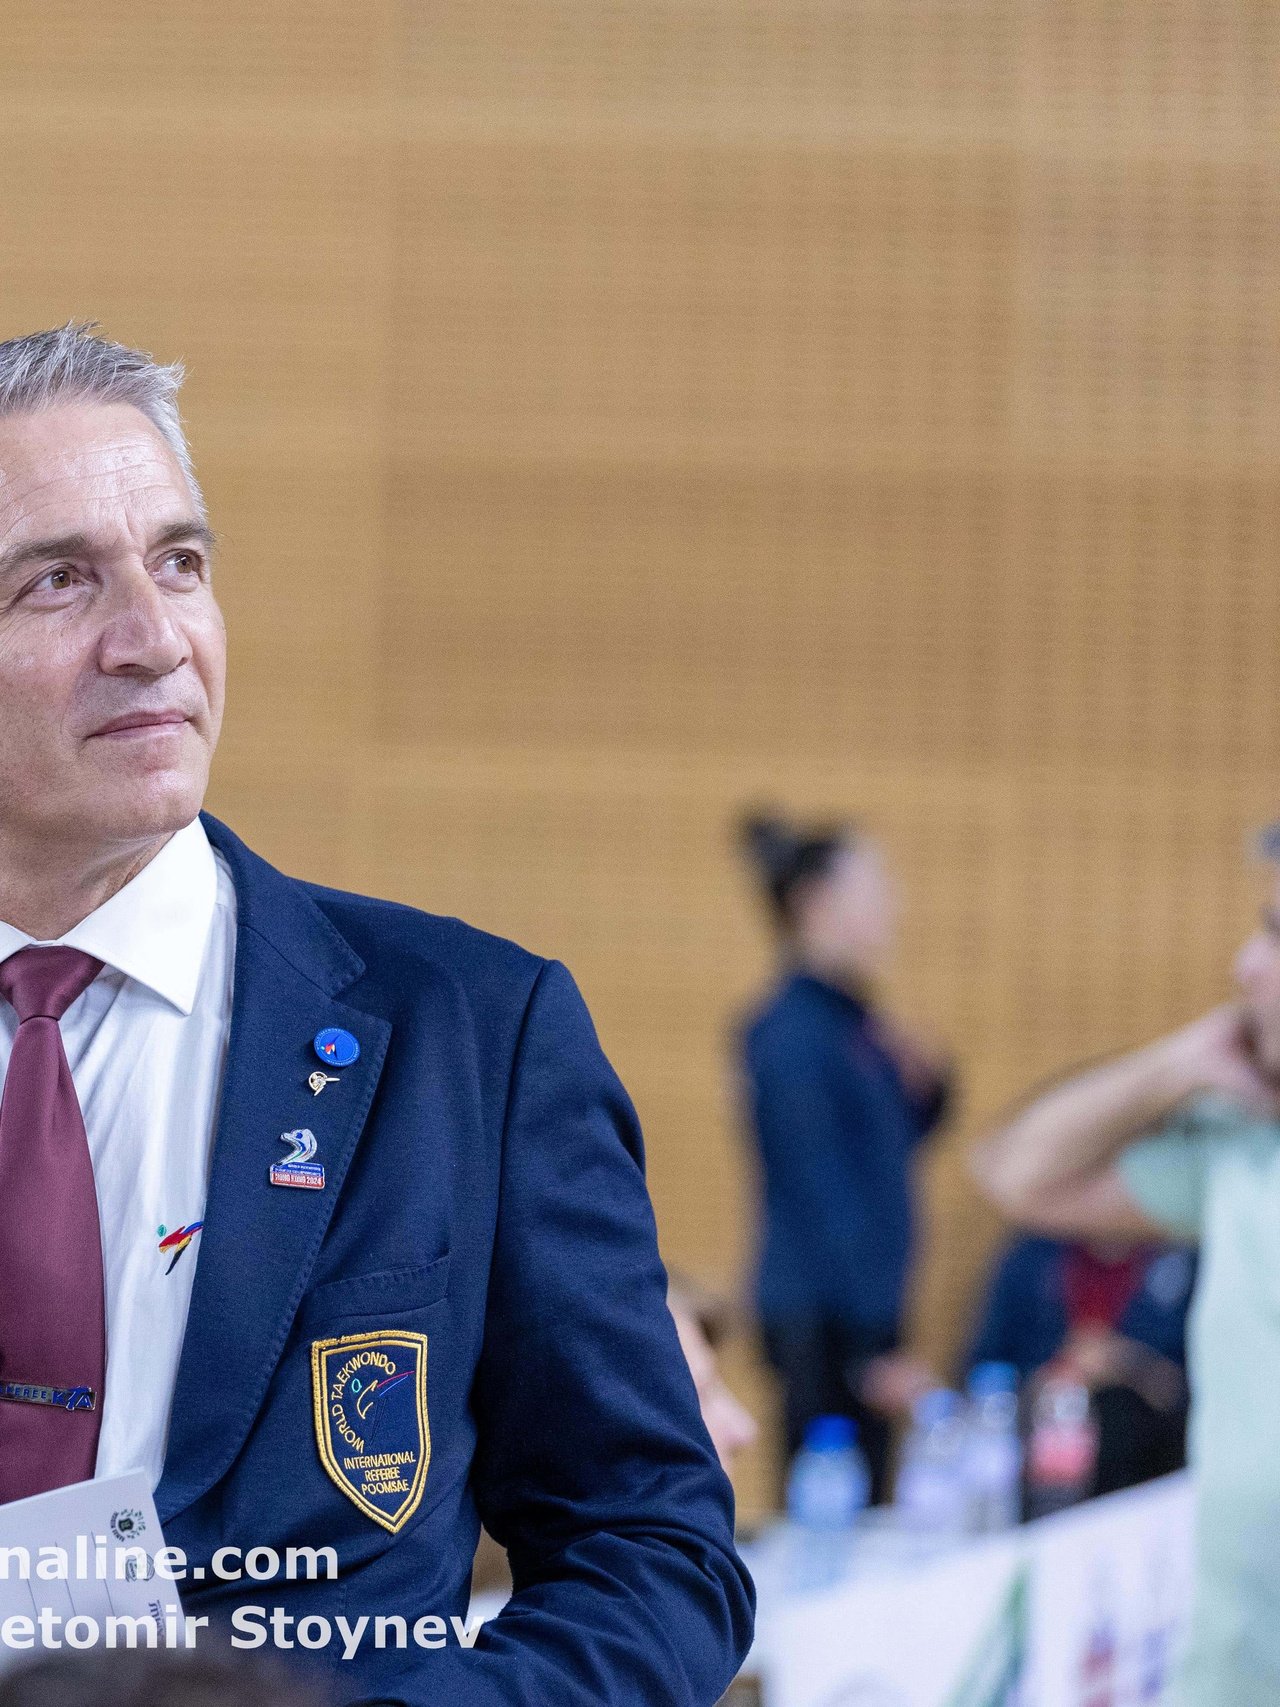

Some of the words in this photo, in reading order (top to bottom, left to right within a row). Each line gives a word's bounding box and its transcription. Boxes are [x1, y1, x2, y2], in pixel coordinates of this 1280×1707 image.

[332, 1352, 396, 1401] TAEKWONDO
[332, 1404, 365, 1453] WORLD
[344, 1451, 416, 1469] INTERNATIONAL
[365, 1467, 400, 1482] REFEREE
[361, 1479, 410, 1495] POOMSAE
